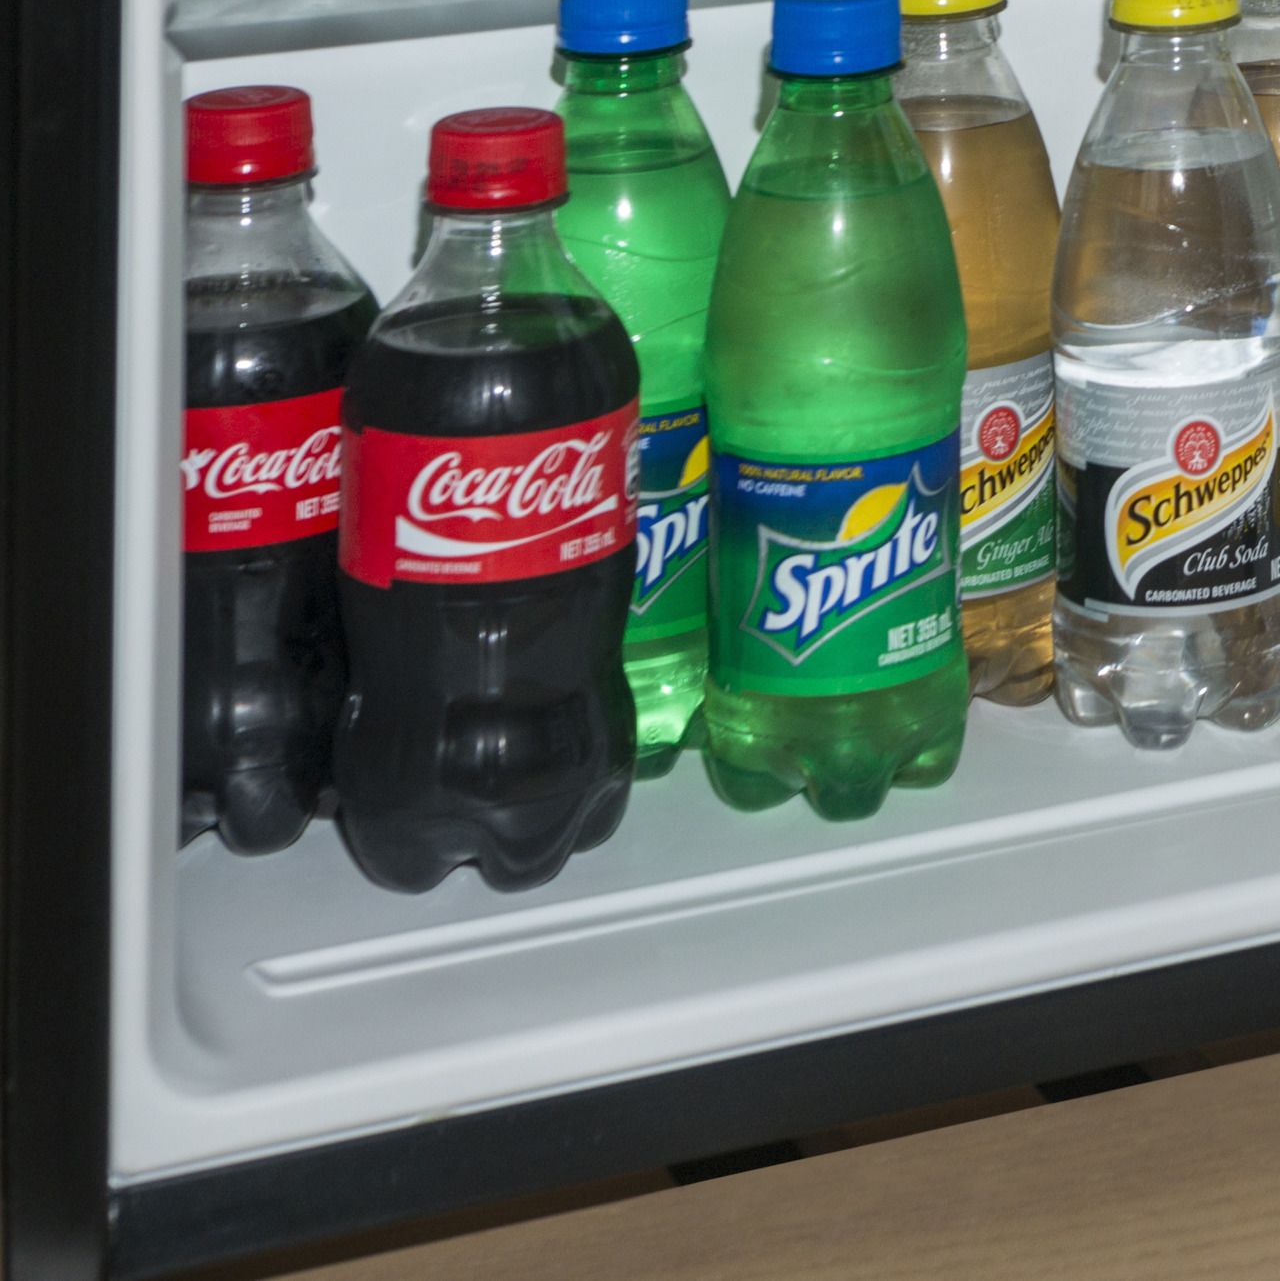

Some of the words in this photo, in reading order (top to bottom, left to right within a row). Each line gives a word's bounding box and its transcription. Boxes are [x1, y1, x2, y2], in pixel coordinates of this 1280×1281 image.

[406, 428, 613, 524] Coca-Cola
[959, 424, 1056, 515] chweppe
[295, 496, 319, 521] NET
[1125, 443, 1269, 547] Schweppes
[559, 539, 583, 562] NET
[636, 494, 710, 588] Spr
[976, 534, 1031, 570] Ginger
[1183, 544, 1228, 577] Club
[1228, 535, 1270, 569] Soda
[762, 496, 939, 639] Sprite
[1145, 586, 1211, 603] CARBONATED
[1212, 577, 1258, 598] BEVERAGE
[887, 621, 916, 652] NET
